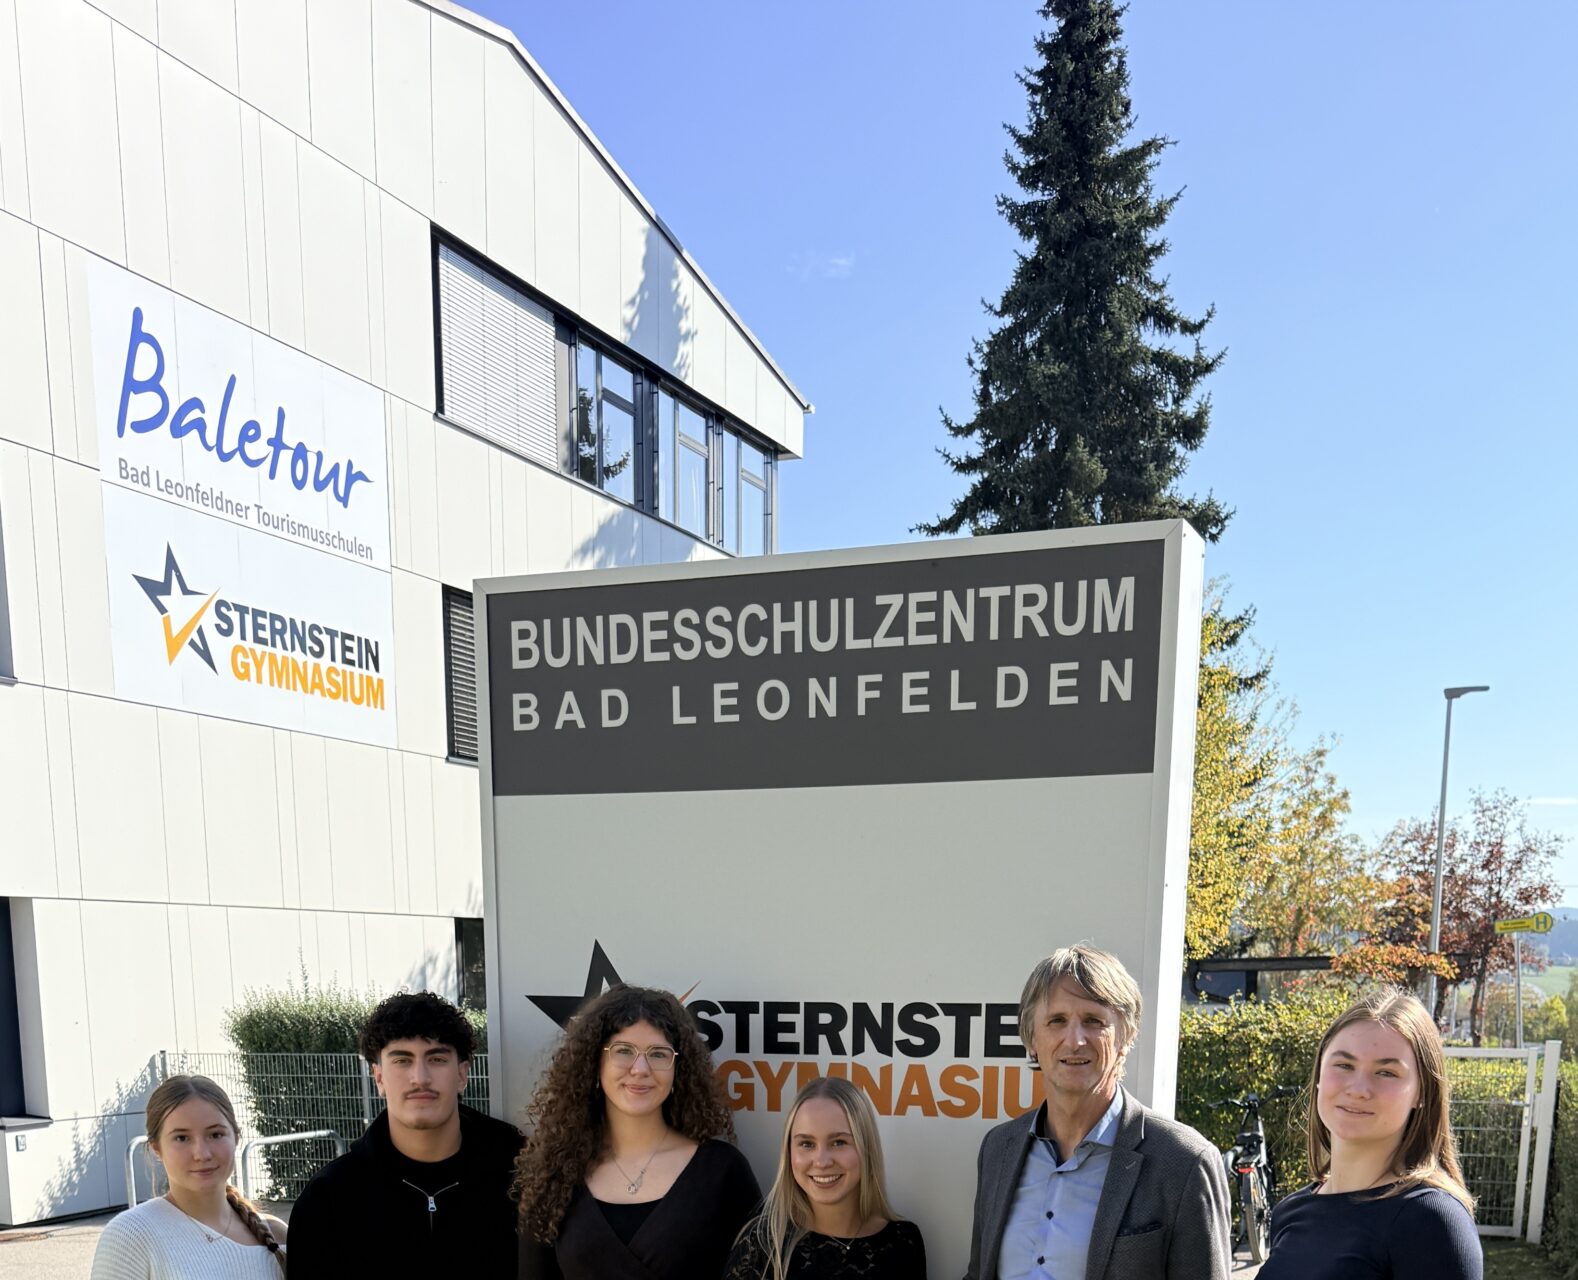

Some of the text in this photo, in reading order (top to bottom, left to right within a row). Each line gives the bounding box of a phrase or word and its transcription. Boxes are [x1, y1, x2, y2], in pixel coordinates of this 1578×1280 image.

[117, 306, 375, 508] Baletour
[118, 457, 373, 560] Bad Leonfeldner Tourismusschulen
[214, 599, 380, 673] STERNSTEIN
[510, 576, 1136, 670] BUNDESSCHULZENTRUM
[231, 644, 385, 710] GYMNASIUM
[513, 658, 1134, 731] BAD LEONFELDEN
[685, 999, 1027, 1059] STERNSTE
